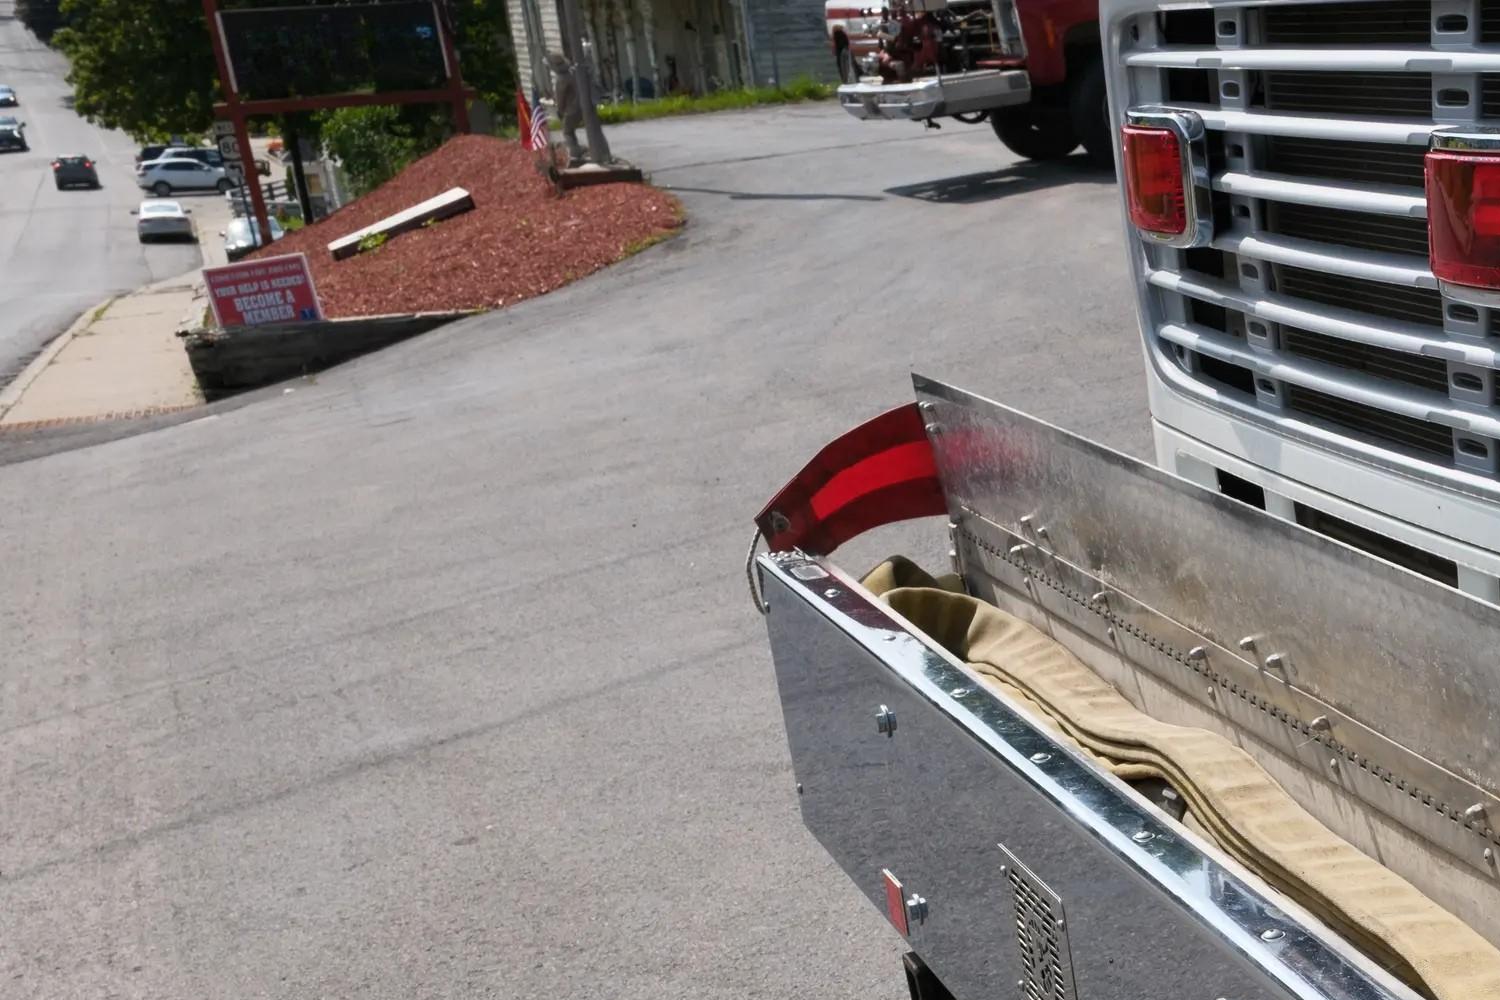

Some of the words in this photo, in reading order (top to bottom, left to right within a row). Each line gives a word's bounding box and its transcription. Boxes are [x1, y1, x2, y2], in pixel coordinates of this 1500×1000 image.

[234, 291, 284, 312] BECOME
[286, 289, 296, 304] A
[243, 304, 296, 325] MEMBER
